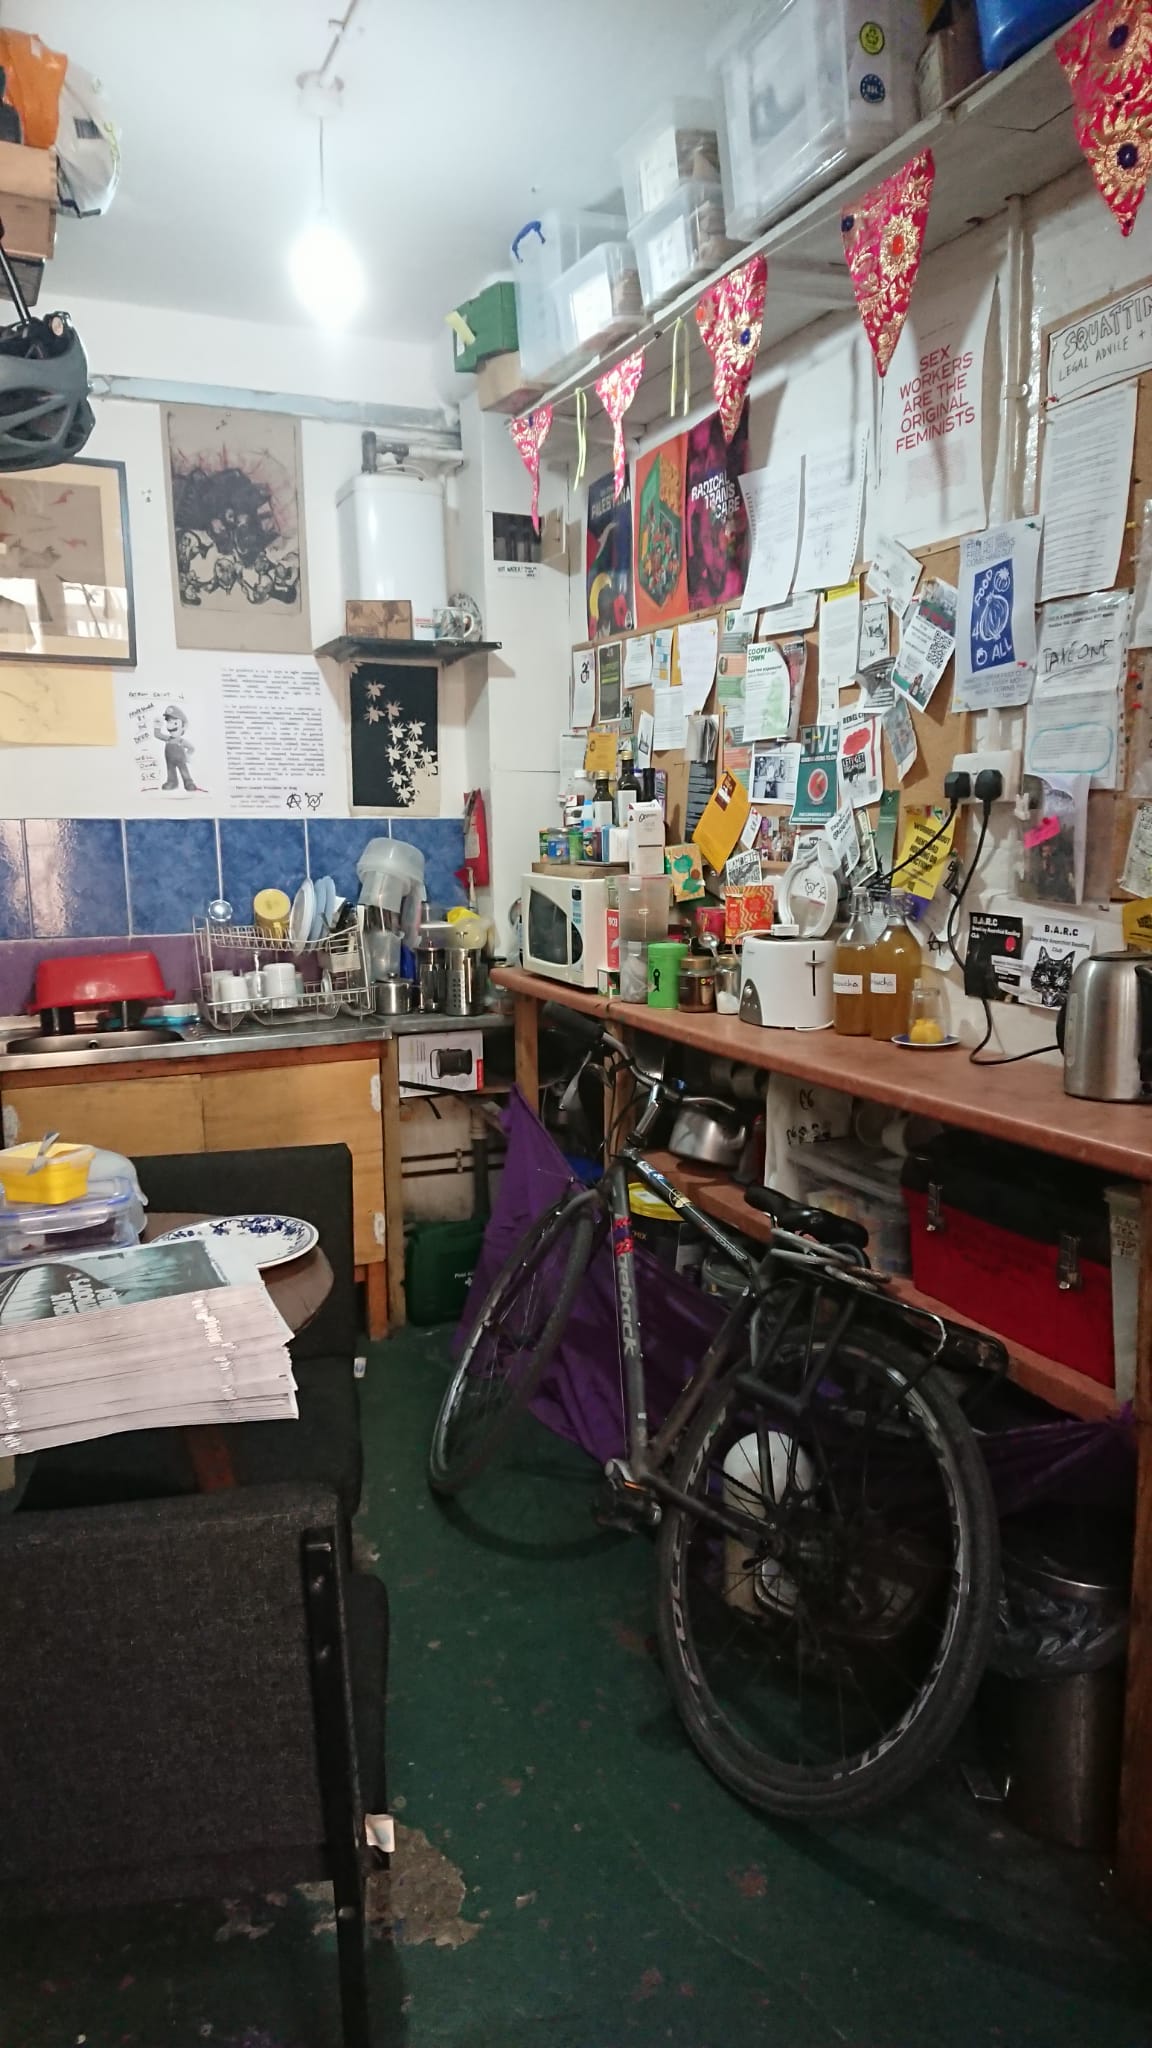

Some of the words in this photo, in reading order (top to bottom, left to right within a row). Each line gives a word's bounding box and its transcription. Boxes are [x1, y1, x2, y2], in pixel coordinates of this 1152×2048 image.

[900, 351, 973, 400] WORKERS
[920, 344, 951, 373] SEX
[1058, 357, 1089, 382] LEGAL
[901, 393, 969, 434] ORIGINAL
[903, 390, 933, 416] ARE
[937, 372, 968, 398] THE
[896, 406, 976, 454] FEMINISTS
[974, 569, 993, 607] FOOD
[971, 620, 980, 640] 4
[991, 637, 1013, 661] ALL
[1044, 924, 1079, 937] B.A.R.C
